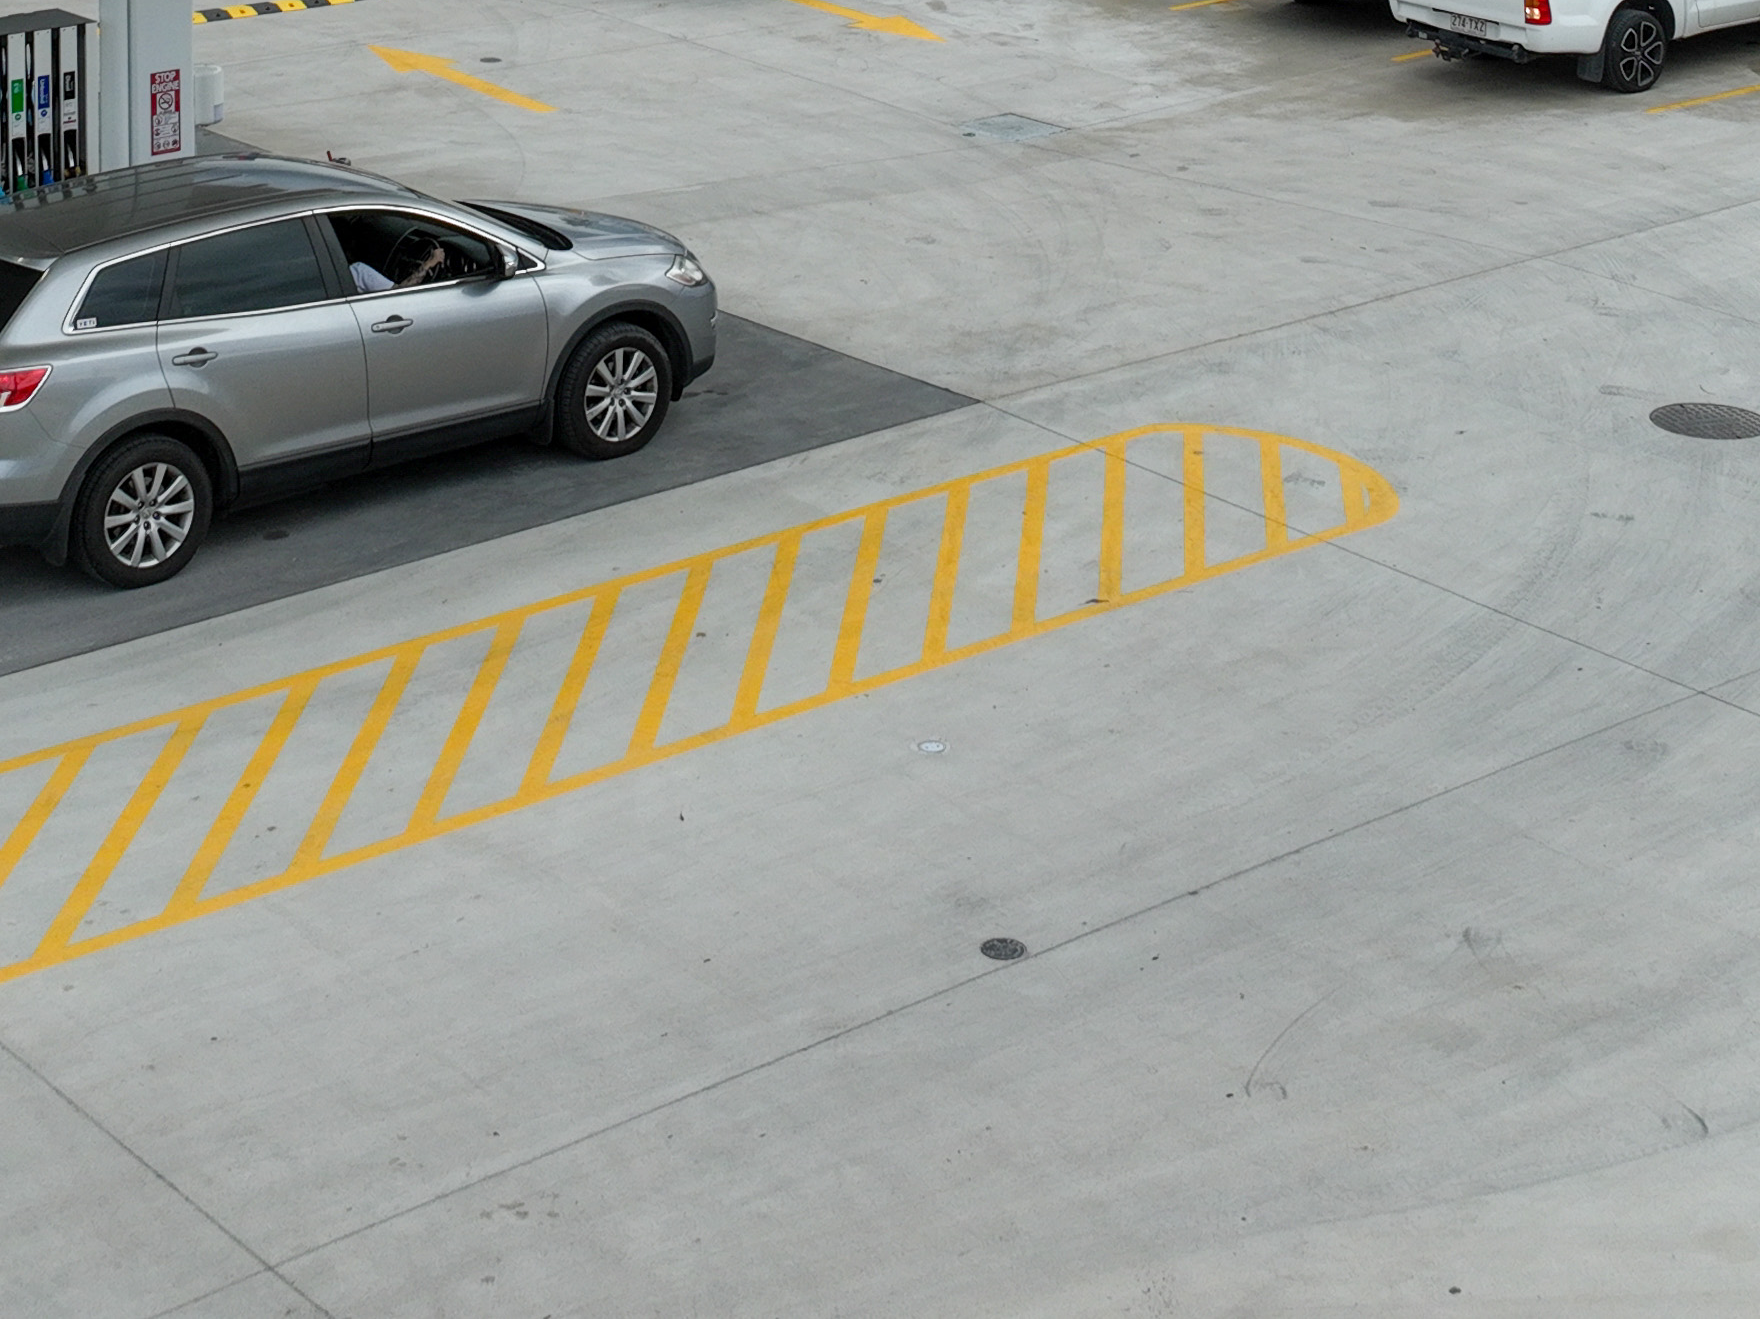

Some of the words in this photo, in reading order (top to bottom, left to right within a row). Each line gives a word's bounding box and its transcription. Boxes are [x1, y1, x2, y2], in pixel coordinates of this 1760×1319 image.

[154, 71, 177, 83] STOP
[152, 80, 180, 93] ENGINE
[79, 319, 96, 328] YETI
